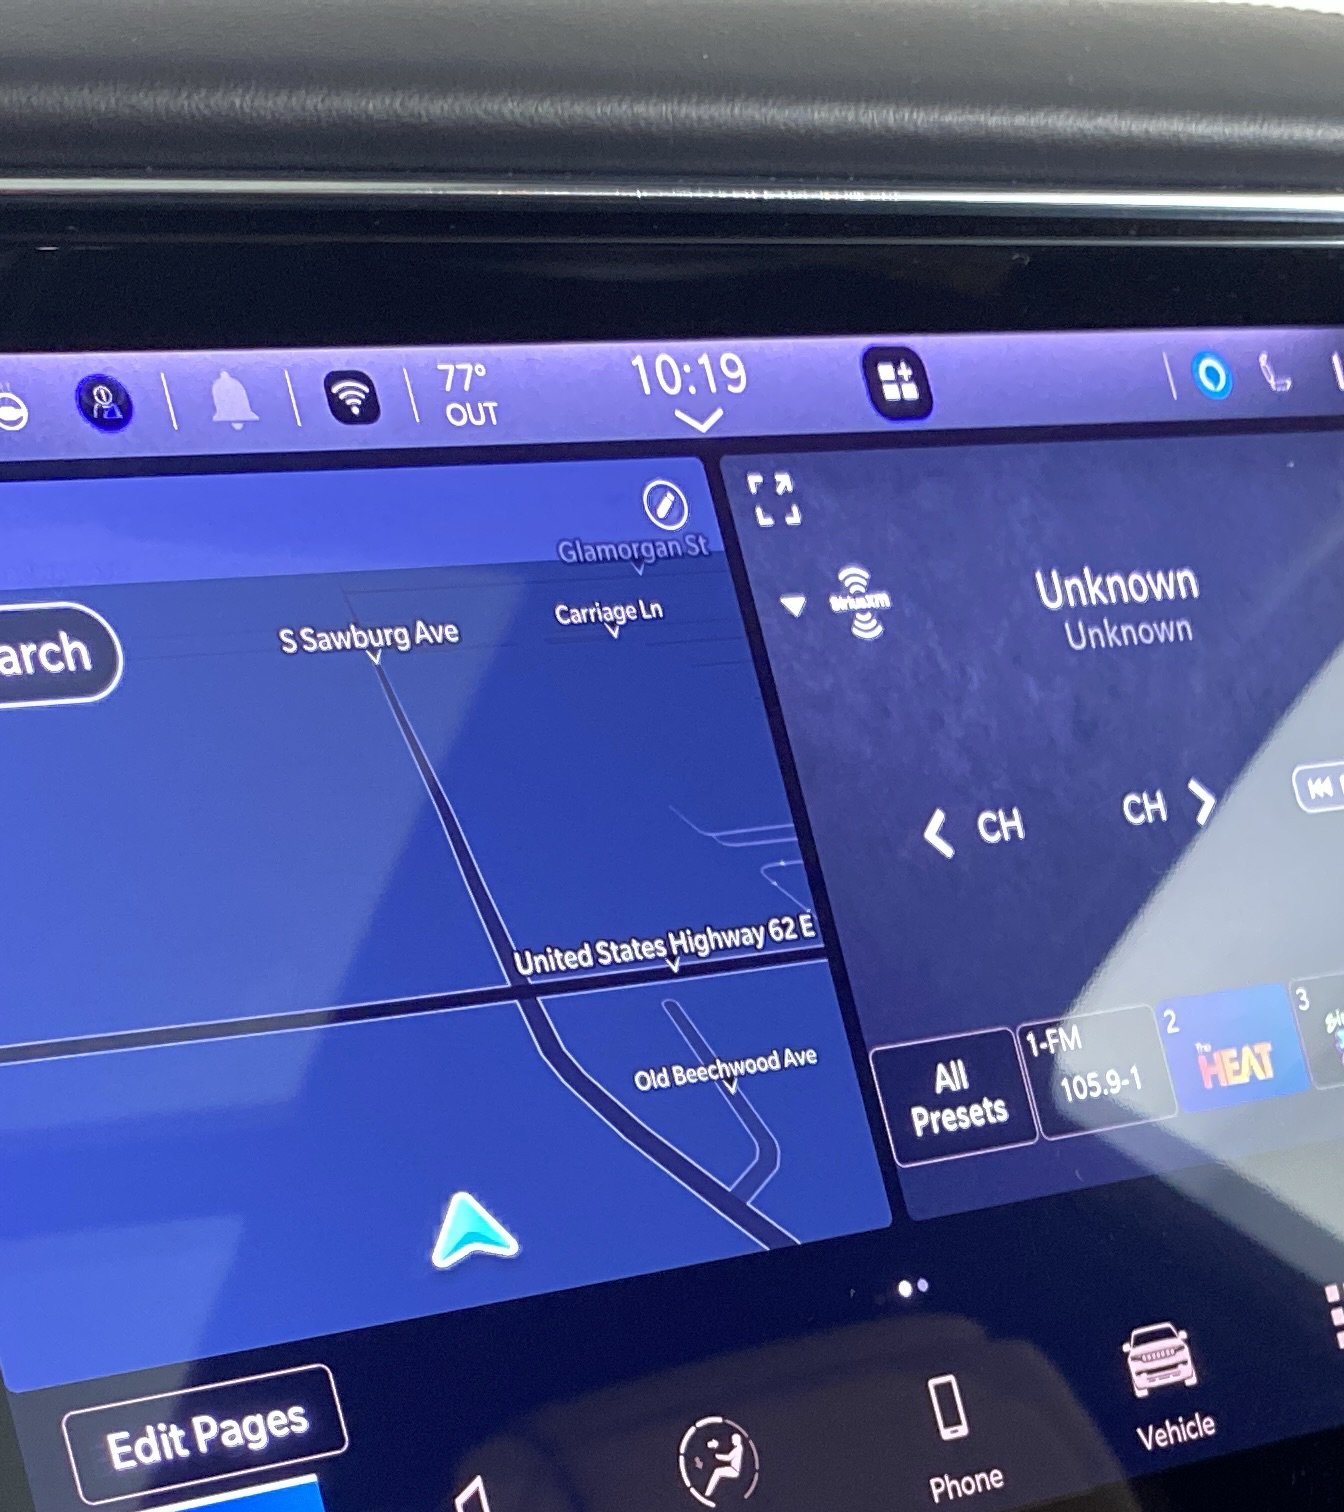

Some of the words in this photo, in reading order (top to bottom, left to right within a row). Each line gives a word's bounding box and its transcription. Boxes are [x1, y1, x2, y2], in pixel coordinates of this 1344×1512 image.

[632, 352, 746, 394] 10:19
[446, 402, 497, 426] OUT
[558, 540, 682, 563] Glamorgan
[689, 534, 710, 556] St
[1036, 567, 1198, 610] Unknown
[555, 602, 637, 625] Carriage
[639, 600, 663, 619] Ln
[280, 629, 297, 653] S
[300, 625, 410, 651] Sawburg
[416, 621, 458, 643] Ave
[1065, 618, 1192, 650] Unknown
[1123, 790, 1167, 825] CH
[978, 808, 1024, 843] CH
[514, 943, 593, 975] United
[596, 939, 667, 965] States
[667, 922, 766, 957] Highway
[769, 917, 797, 941] 62
[799, 914, 815, 937] E
[1296, 987, 1309, 1010] 3
[1164, 1009, 1179, 1033] 2
[1026, 1026, 1082, 1058] 1-FM
[635, 1067, 670, 1090] Old
[672, 1054, 780, 1086] Beechwood
[785, 1048, 817, 1067] Ave
[936, 1059, 969, 1094] All
[1197, 1042, 1274, 1089] HEAT
[1059, 1064, 1143, 1103] 105.9-1
[911, 1097, 1009, 1137] Presets
[107, 1423, 190, 1470] Edit
[192, 1406, 309, 1453] Pages
[1137, 1413, 1215, 1450] Vehicle
[930, 1469, 1004, 1503] Phone
